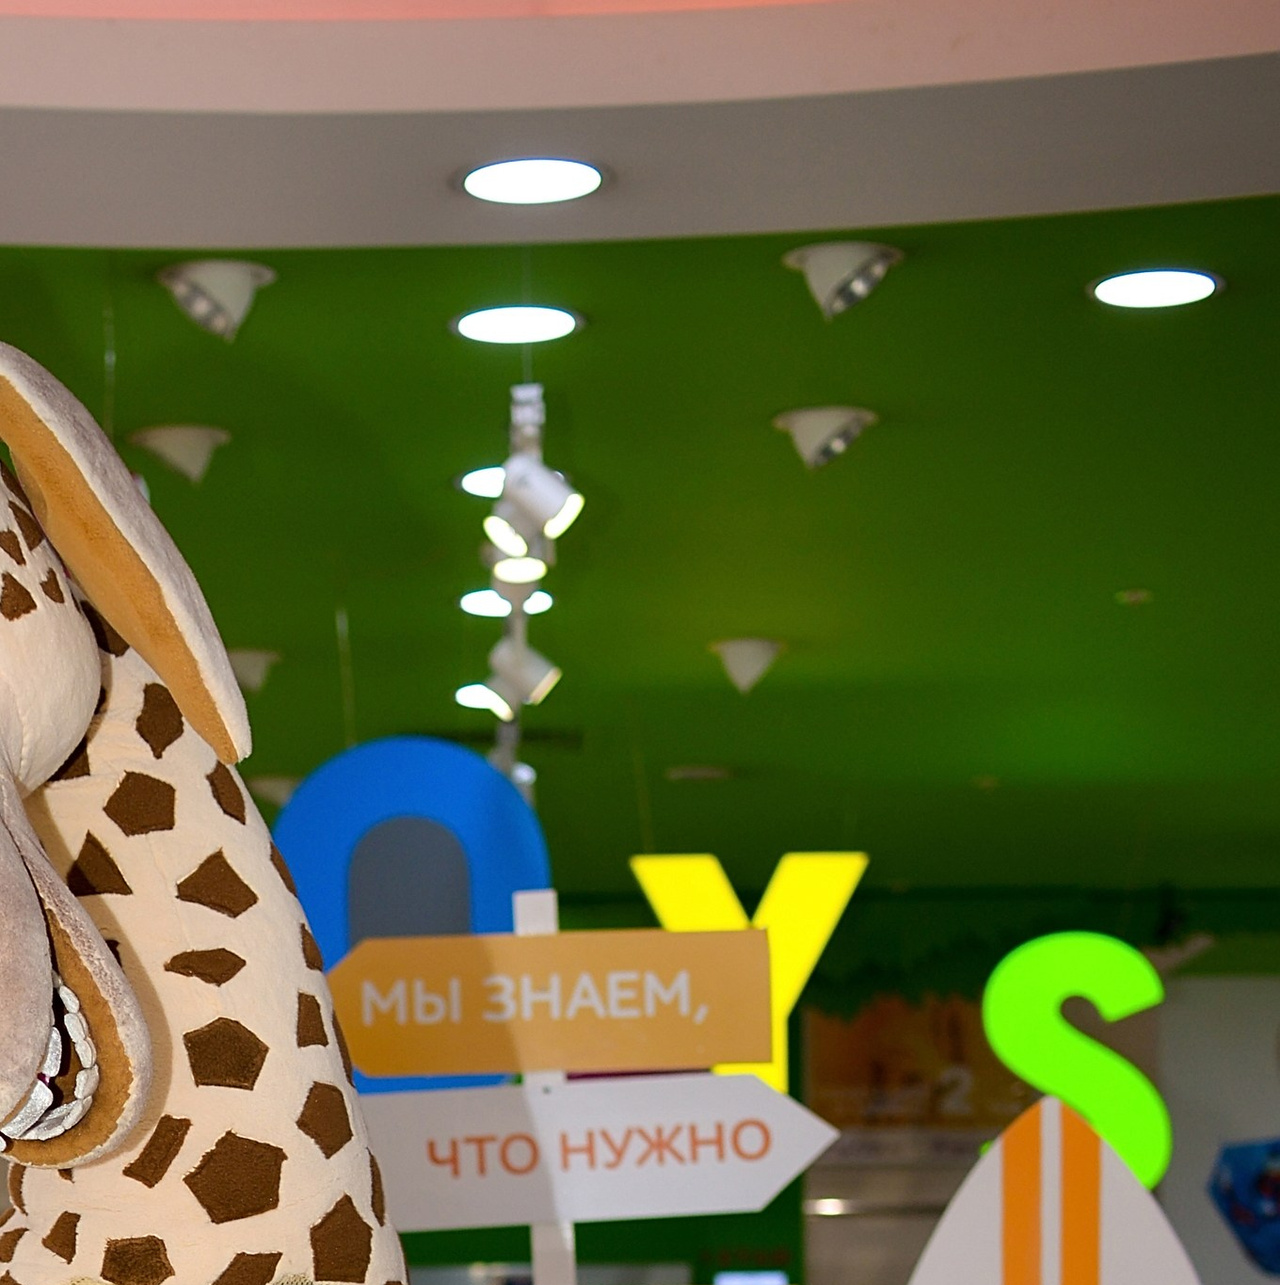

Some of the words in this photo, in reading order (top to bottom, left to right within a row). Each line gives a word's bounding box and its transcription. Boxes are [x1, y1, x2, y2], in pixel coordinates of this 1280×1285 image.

[361, 977, 462, 1027] МЫ
[481, 970, 709, 1025] ЗНАЕМ,
[426, 1132, 540, 1179] ЧТО
[559, 1118, 772, 1171] НУЖНО
